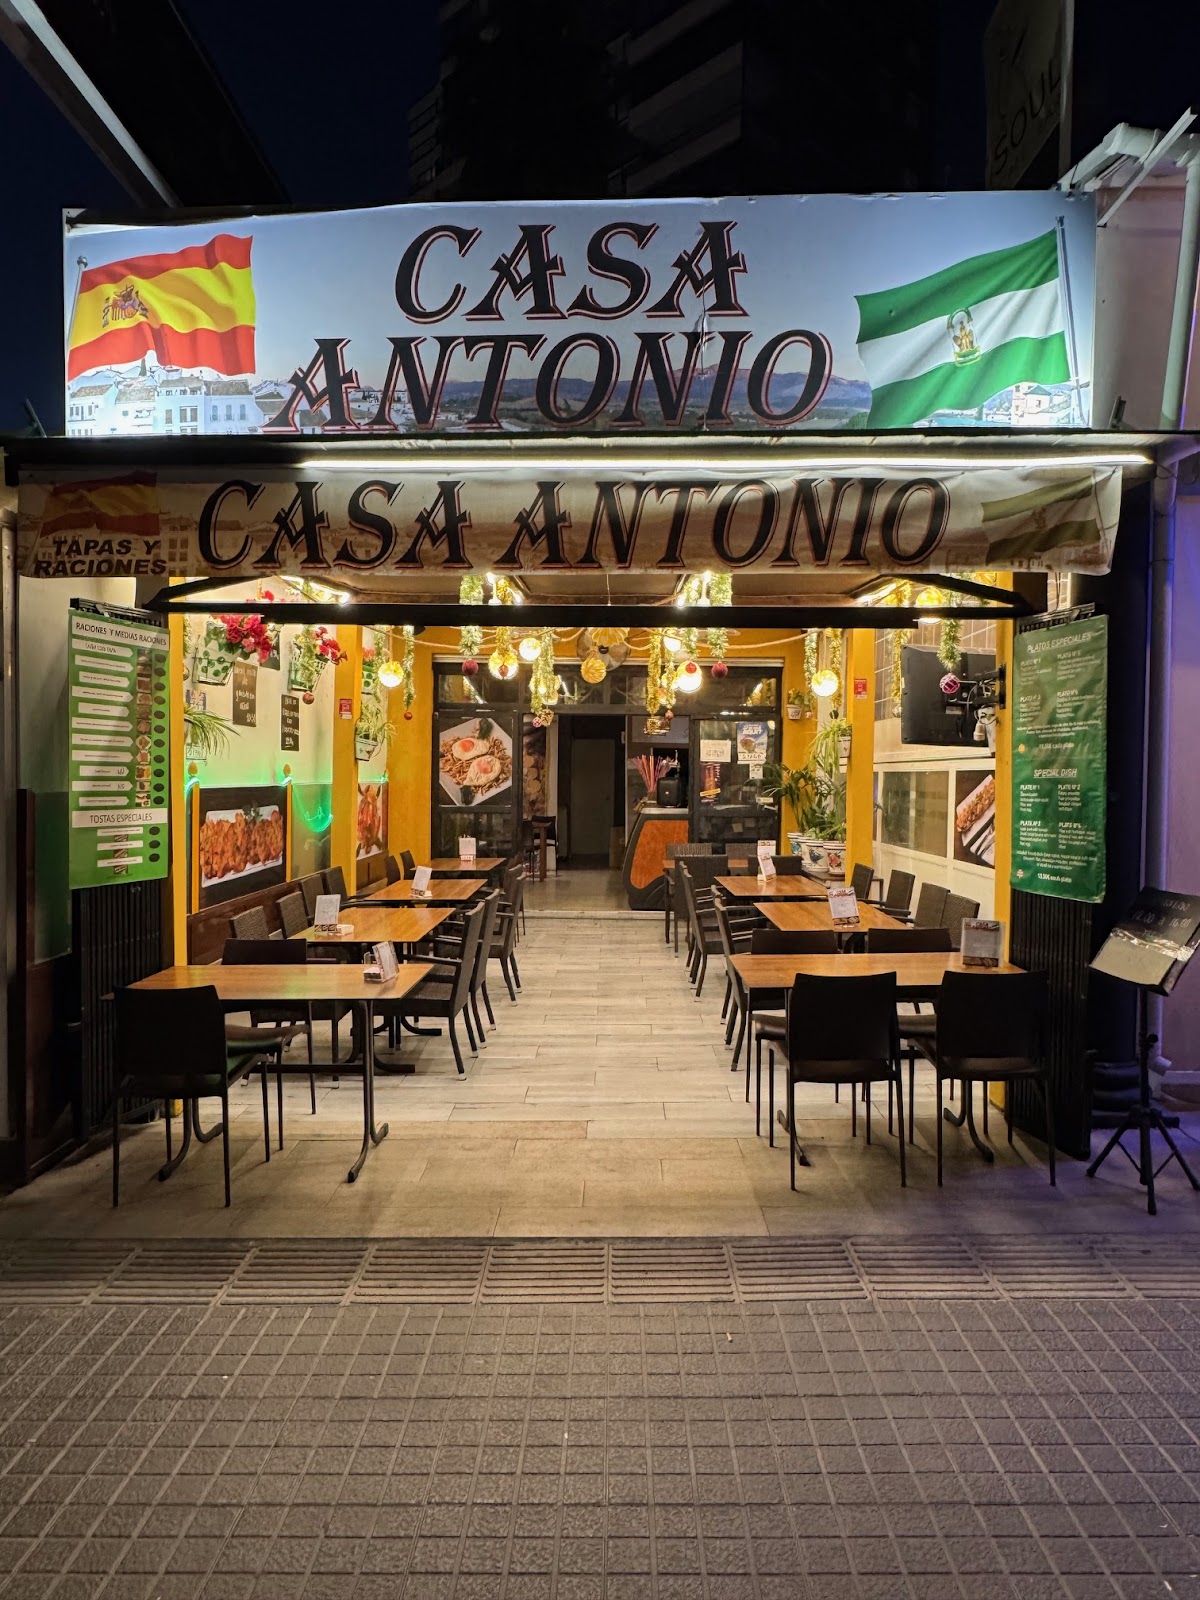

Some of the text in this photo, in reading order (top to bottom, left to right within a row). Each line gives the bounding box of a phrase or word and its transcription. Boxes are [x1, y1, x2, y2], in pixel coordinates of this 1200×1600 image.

[394, 220, 749, 324] CASA
[261, 328, 833, 433] ANTONIO
[200, 477, 951, 570] CASA ANTONIO
[52, 539, 161, 556] TAPAS Y
[33, 559, 167, 576] RACIONES
[75, 622, 167, 646] RACIONES Y MEDIAS RACIONES
[1026, 632, 1092, 653] PLATOS ESPECIALES
[1034, 768, 1077, 778] SPECIAL DISH
[90, 812, 153, 823] TOSTAS ESPECIALES
